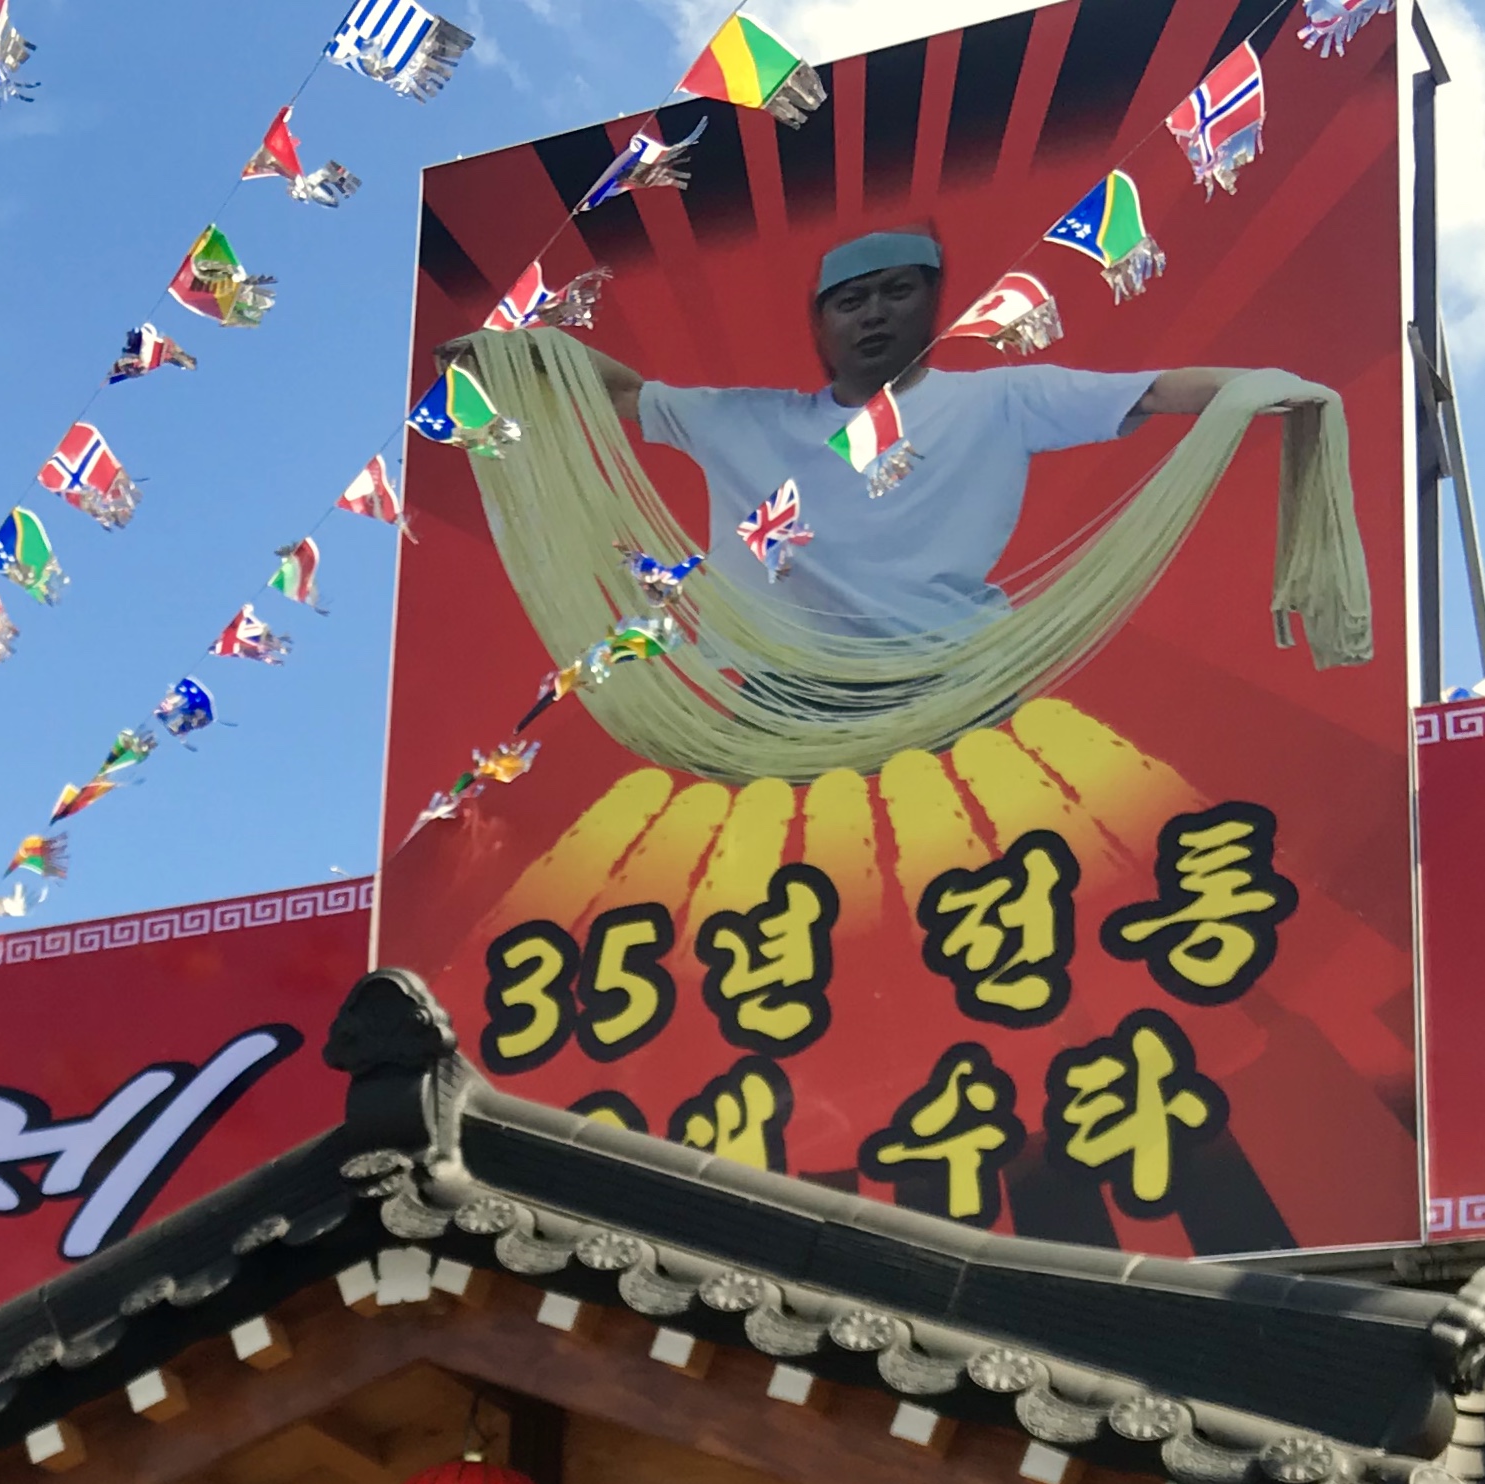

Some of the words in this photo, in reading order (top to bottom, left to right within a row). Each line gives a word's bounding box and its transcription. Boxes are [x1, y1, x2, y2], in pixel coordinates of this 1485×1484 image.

[495, 879, 823, 1059] 35년
[934, 819, 1277, 1011] 전통
[876, 1027, 1209, 1218] 수타
